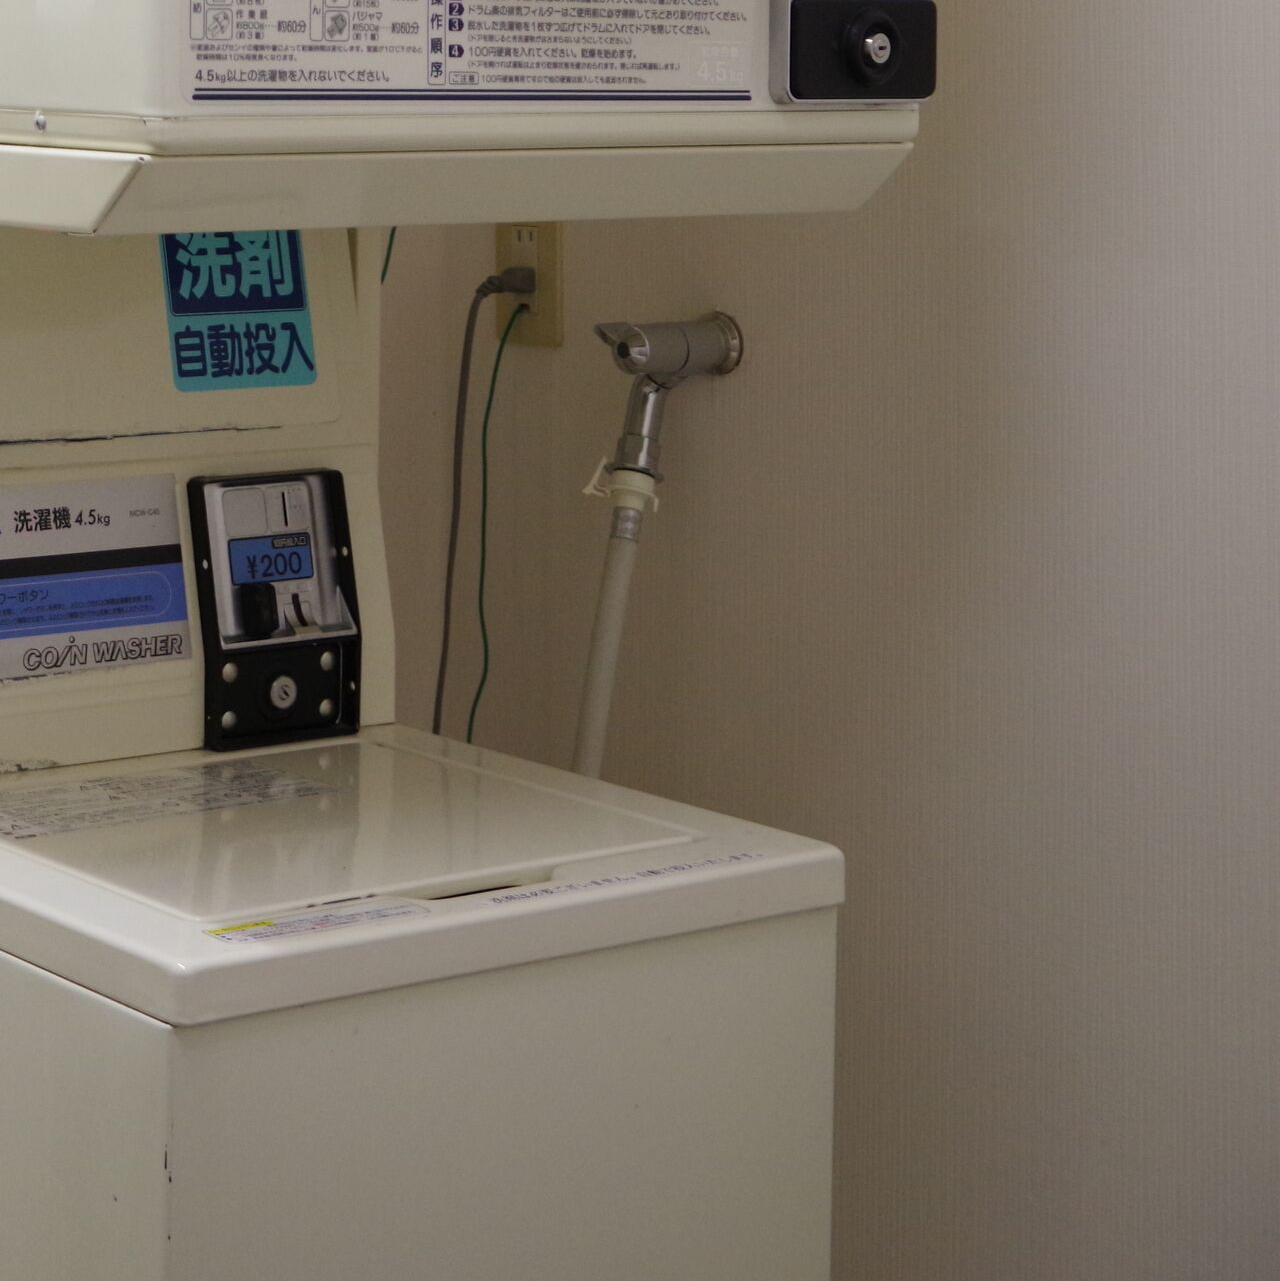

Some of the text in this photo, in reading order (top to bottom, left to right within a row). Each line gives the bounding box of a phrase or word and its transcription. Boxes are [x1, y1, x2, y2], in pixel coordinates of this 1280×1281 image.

[175, 230, 294, 299] 洗剤
[174, 322, 314, 378] 自動投入
[14, 507, 71, 533] 洗濯機
[75, 510, 110, 526] 4.5kg
[246, 552, 302, 579] ¥200
[93, 634, 183, 663] WASHER
